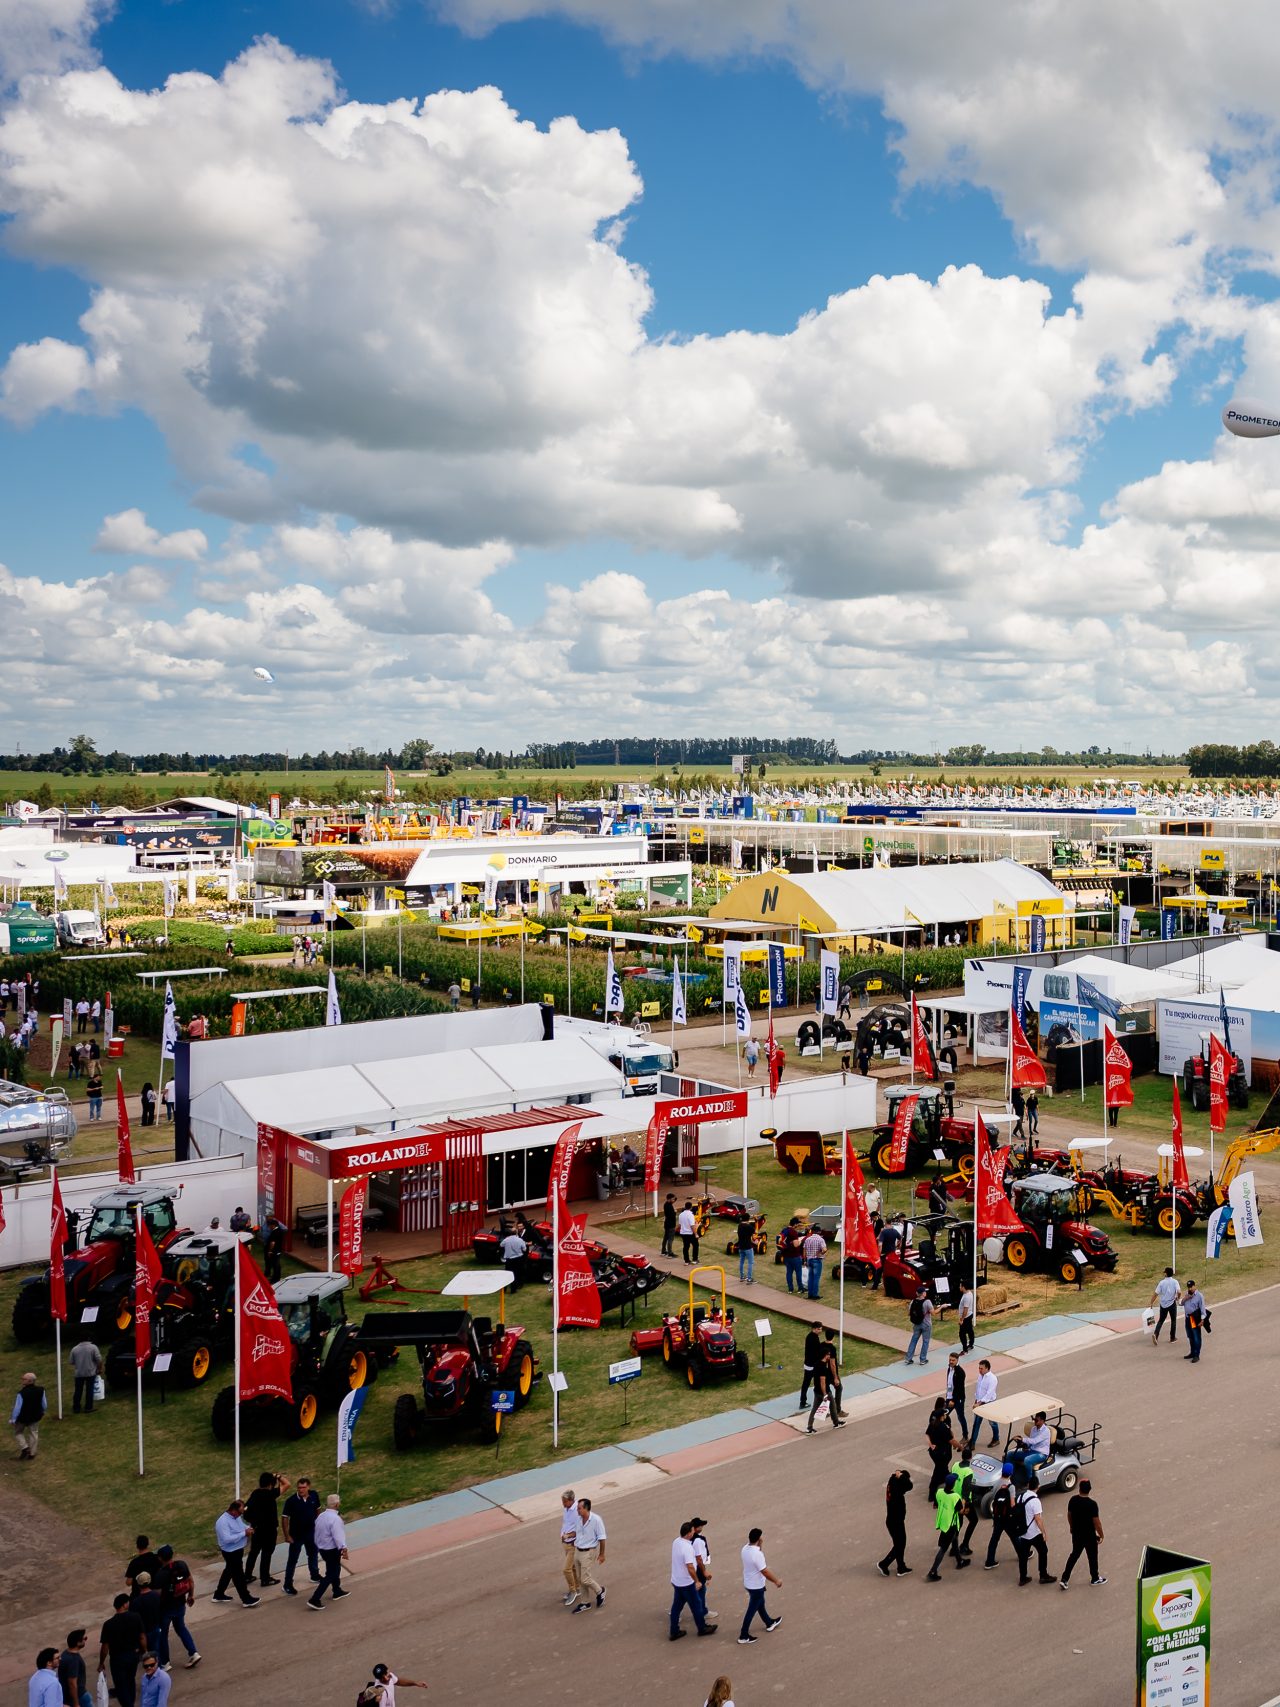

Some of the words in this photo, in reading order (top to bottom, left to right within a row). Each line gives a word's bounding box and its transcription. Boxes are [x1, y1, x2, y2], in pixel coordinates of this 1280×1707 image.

[876, 841, 893, 849] JOHN
[893, 841, 915, 850] DEERE
[508, 855, 557, 865] DONMARIO
[1205, 854, 1220, 862] PLA
[762, 885, 779, 914] N
[16, 935, 48, 944] spraytec
[775, 950, 785, 1004] PROMETEON
[1165, 1008, 1174, 1017] Tu
[1174, 1010, 1198, 1021] negocio
[1198, 1013, 1215, 1022] crece
[1242, 1181, 1250, 1199] Agro
[1245, 1200, 1254, 1224] Macro
[1218, 1222, 1226, 1235] BNA
[1161, 1600, 1193, 1616] Expoagro
[1180, 1611, 1193, 1619] agro
[1146, 1633, 1171, 1648] ZONA
[1172, 1625, 1207, 1640] STANDS
[1152, 1644, 1165, 1653] DE
[1166, 1635, 1201, 1651] MEDIOS
[1153, 1659, 1170, 1669] Rural
